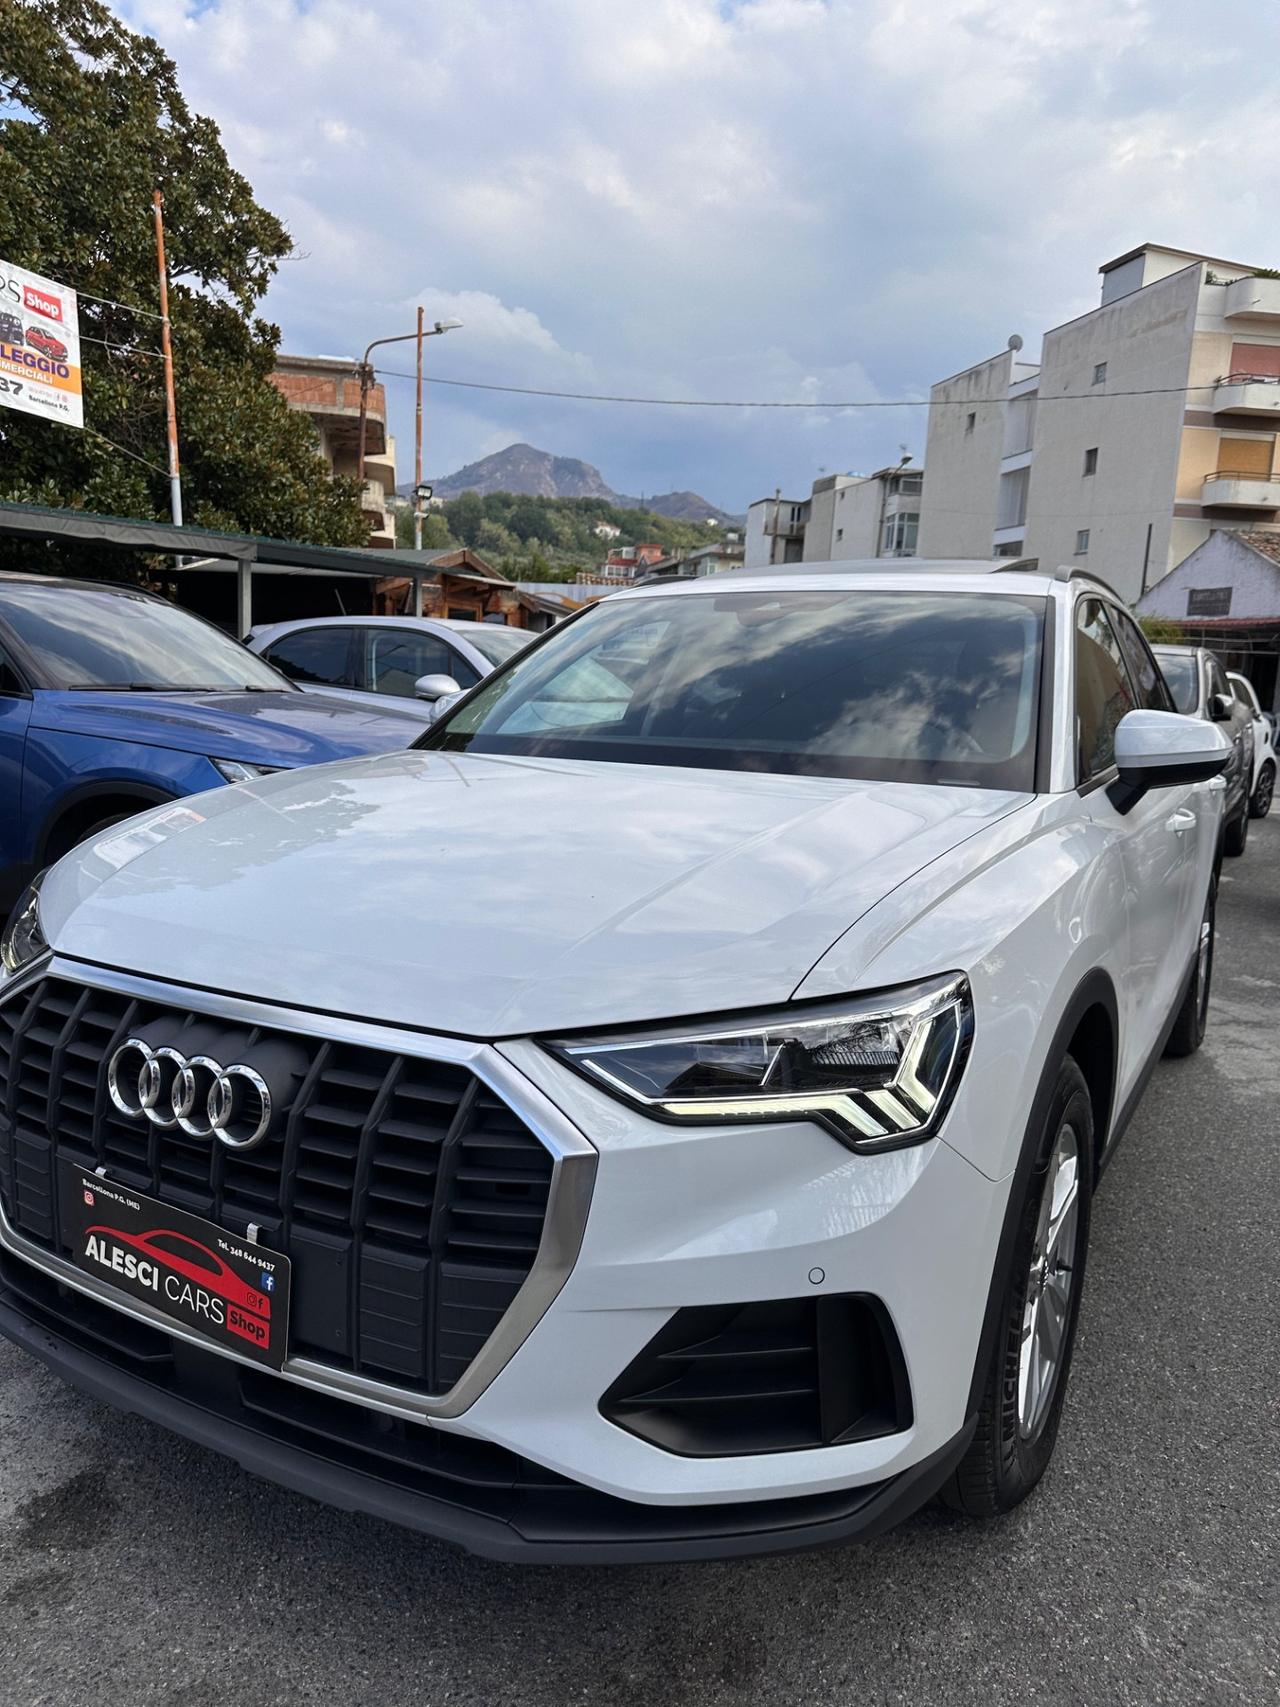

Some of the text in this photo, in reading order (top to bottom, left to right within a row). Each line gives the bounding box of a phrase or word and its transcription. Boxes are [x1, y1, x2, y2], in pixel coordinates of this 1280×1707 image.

[26, 292, 60, 318] Shop
[0, 343, 70, 379] LEGGIO
[0, 360, 53, 385] MERCIALI
[0, 377, 24, 396] 37
[82, 1178, 114, 1199] Barcellona
[230, 1246, 243, 1258] 348
[257, 1258, 276, 1272] 9437
[84, 1235, 266, 1341] ALESCI CARS Shop
